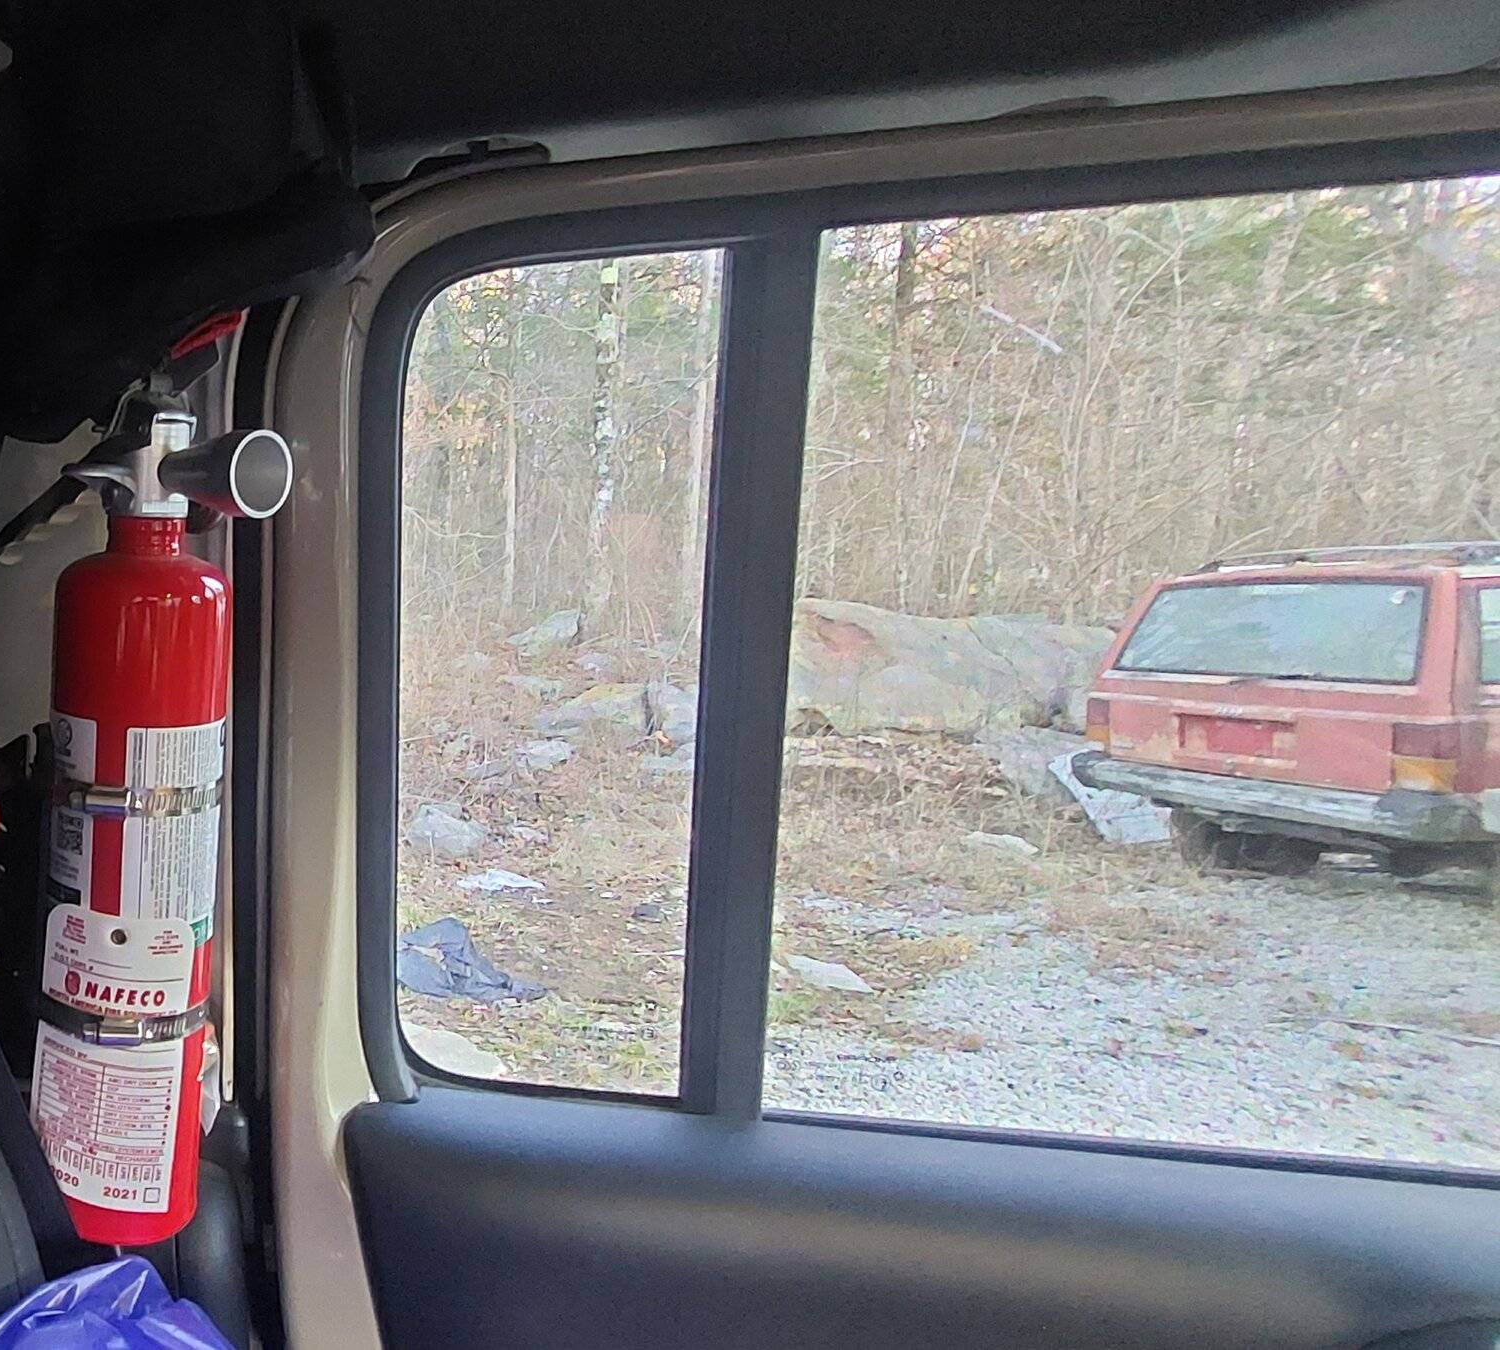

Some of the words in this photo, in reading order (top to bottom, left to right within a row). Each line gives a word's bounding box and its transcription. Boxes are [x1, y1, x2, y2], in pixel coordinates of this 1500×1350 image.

[84, 981, 165, 1007] NAFECO
[71, 997, 103, 1013] AMERICA
[103, 1186, 138, 1200] 2021
